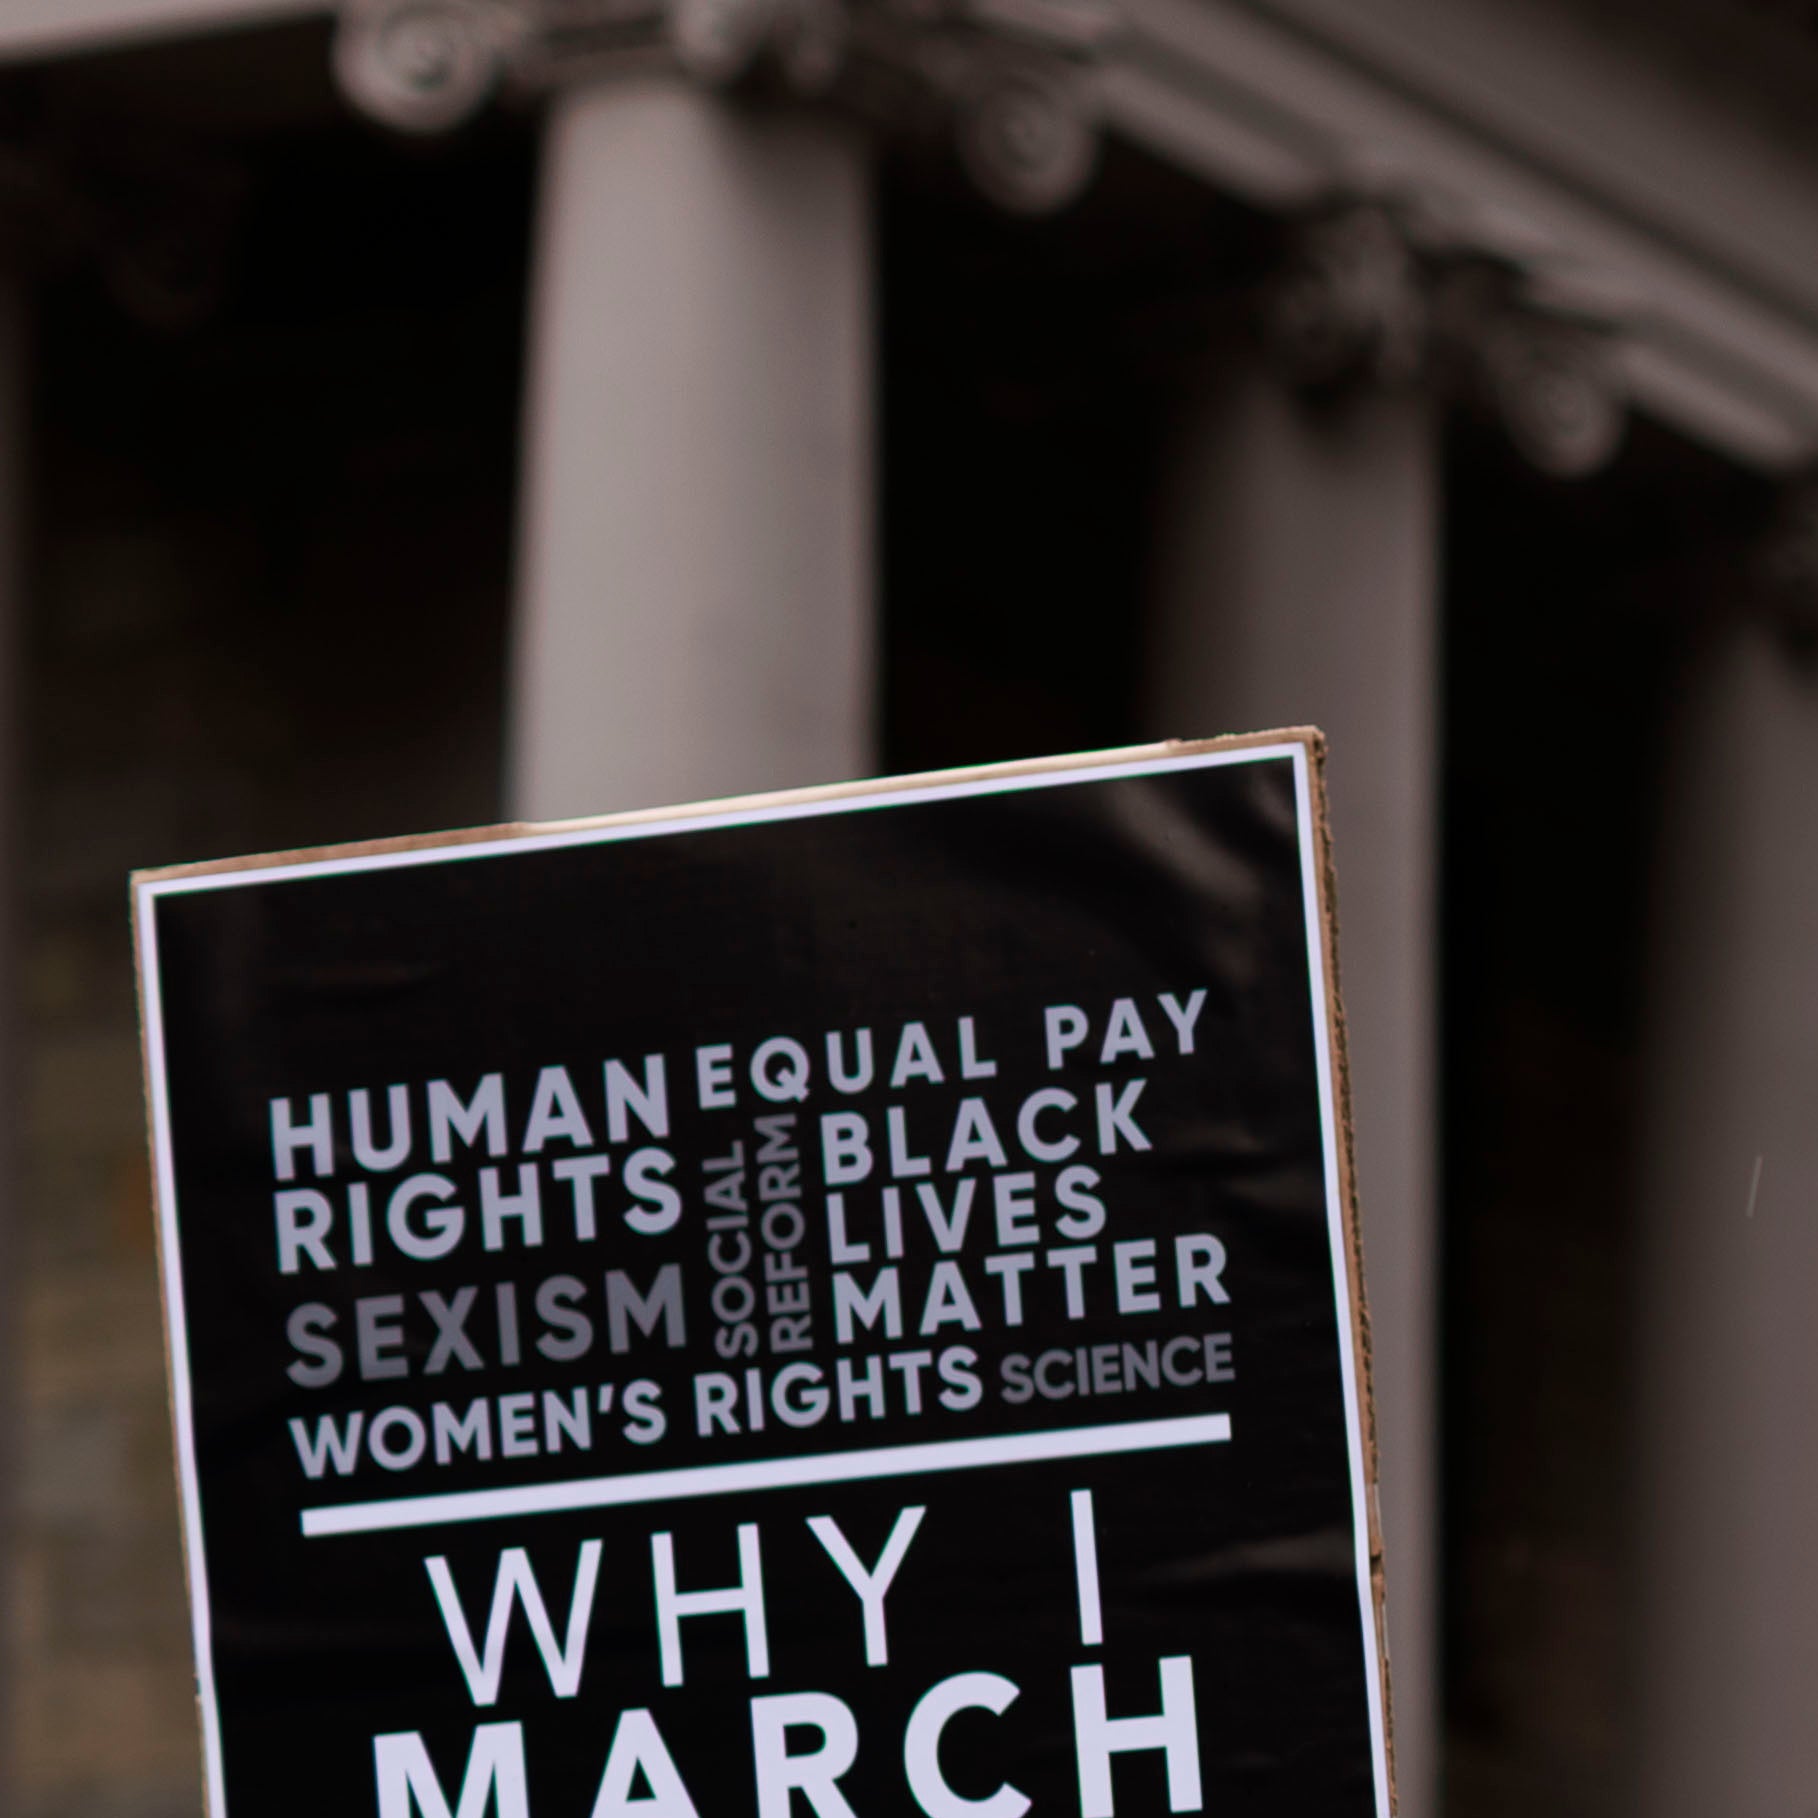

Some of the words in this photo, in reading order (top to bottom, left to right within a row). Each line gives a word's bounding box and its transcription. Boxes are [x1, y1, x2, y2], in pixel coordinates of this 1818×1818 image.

[696, 1017, 996, 1108] EQUAL
[1045, 990, 1206, 1068] PAY
[270, 1055, 668, 1179] HUMAN
[821, 1080, 1151, 1184] BLACK
[275, 1148, 681, 1273] RIGHTS
[702, 1141, 758, 1358] SOCIAL
[754, 1114, 812, 1352] REFORM
[827, 1166, 1105, 1264] LIVES
[287, 1264, 685, 1386] SEXISM
[833, 1234, 1229, 1343] MATTER
[289, 1380, 665, 1477] WOMEN'S
[695, 1346, 982, 1436] RIGHTS
[1001, 1333, 1234, 1402] SCIENCE
[425, 1506, 925, 1706] WHY
[1071, 1490, 1102, 1645] I
